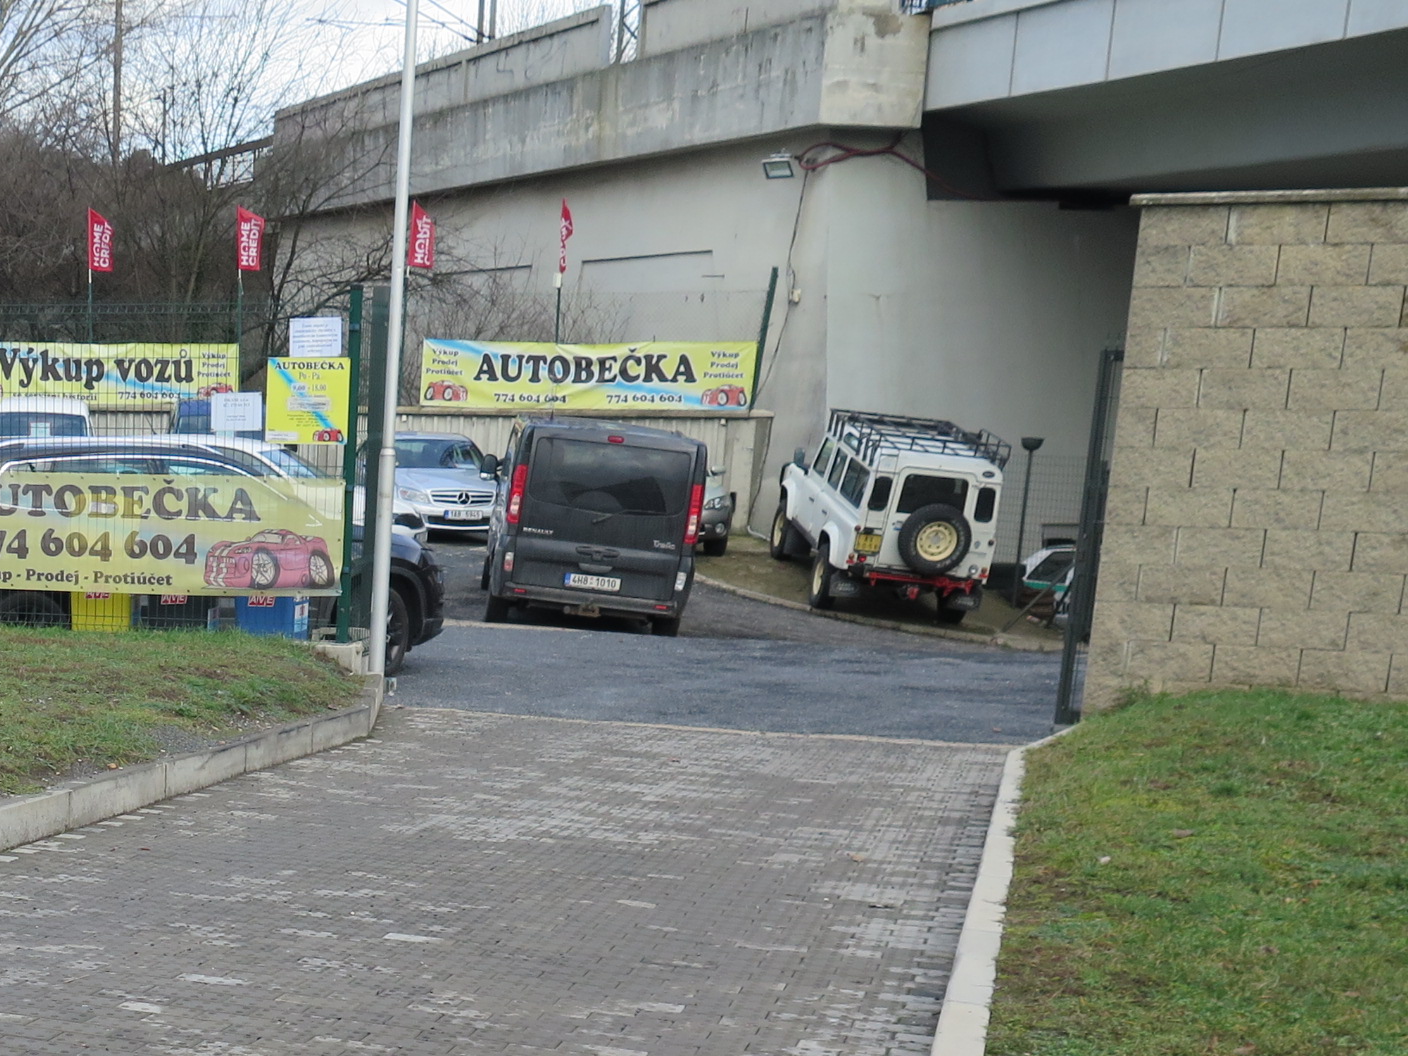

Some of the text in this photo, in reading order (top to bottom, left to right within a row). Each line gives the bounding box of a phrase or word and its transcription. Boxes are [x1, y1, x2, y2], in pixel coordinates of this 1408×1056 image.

[93, 223, 103, 266] HOME
[240, 221, 251, 265] HOME
[248, 219, 261, 266] CREDIT
[432, 347, 459, 357] Výkup
[710, 351, 740, 360] Výkup
[113, 348, 195, 384] vozů
[275, 360, 345, 370] AUTOBEČKA
[431, 357, 459, 367] Prodej
[473, 347, 697, 384] AUTOBEČKA
[710, 361, 739, 370] Prodej
[494, 393, 567, 404] 774 604 604
[606, 394, 683, 404] 774 604 604
[40, 528, 113, 562] 604
[124, 530, 198, 565] 604
[25, 568, 80, 585] Prodej
[92, 570, 173, 586] Protiúčet
[572, 574, 617, 589] 4H8 1010
